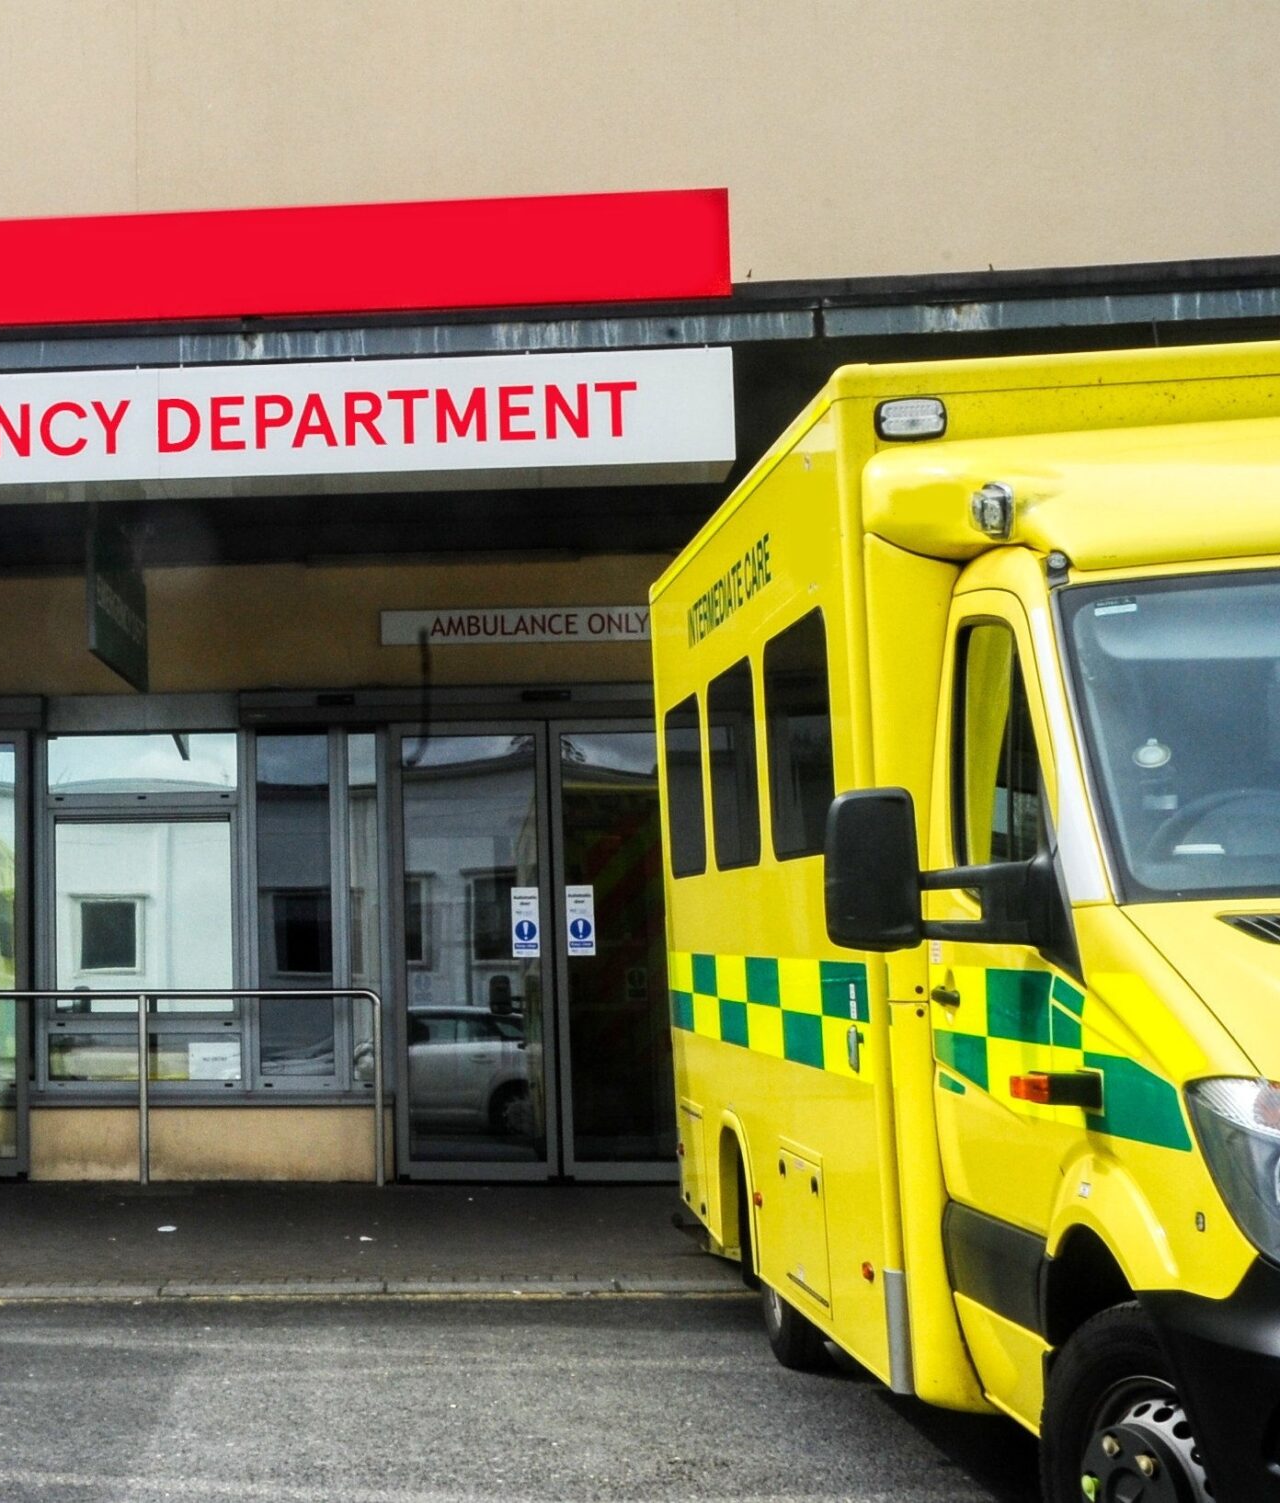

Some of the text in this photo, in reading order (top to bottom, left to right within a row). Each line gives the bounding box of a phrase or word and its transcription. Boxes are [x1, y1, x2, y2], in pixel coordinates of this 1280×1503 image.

[157, 380, 638, 454] DEPARTMENT
[744, 532, 772, 600] CARE
[430, 612, 649, 637] AMBULANCE ONLY
